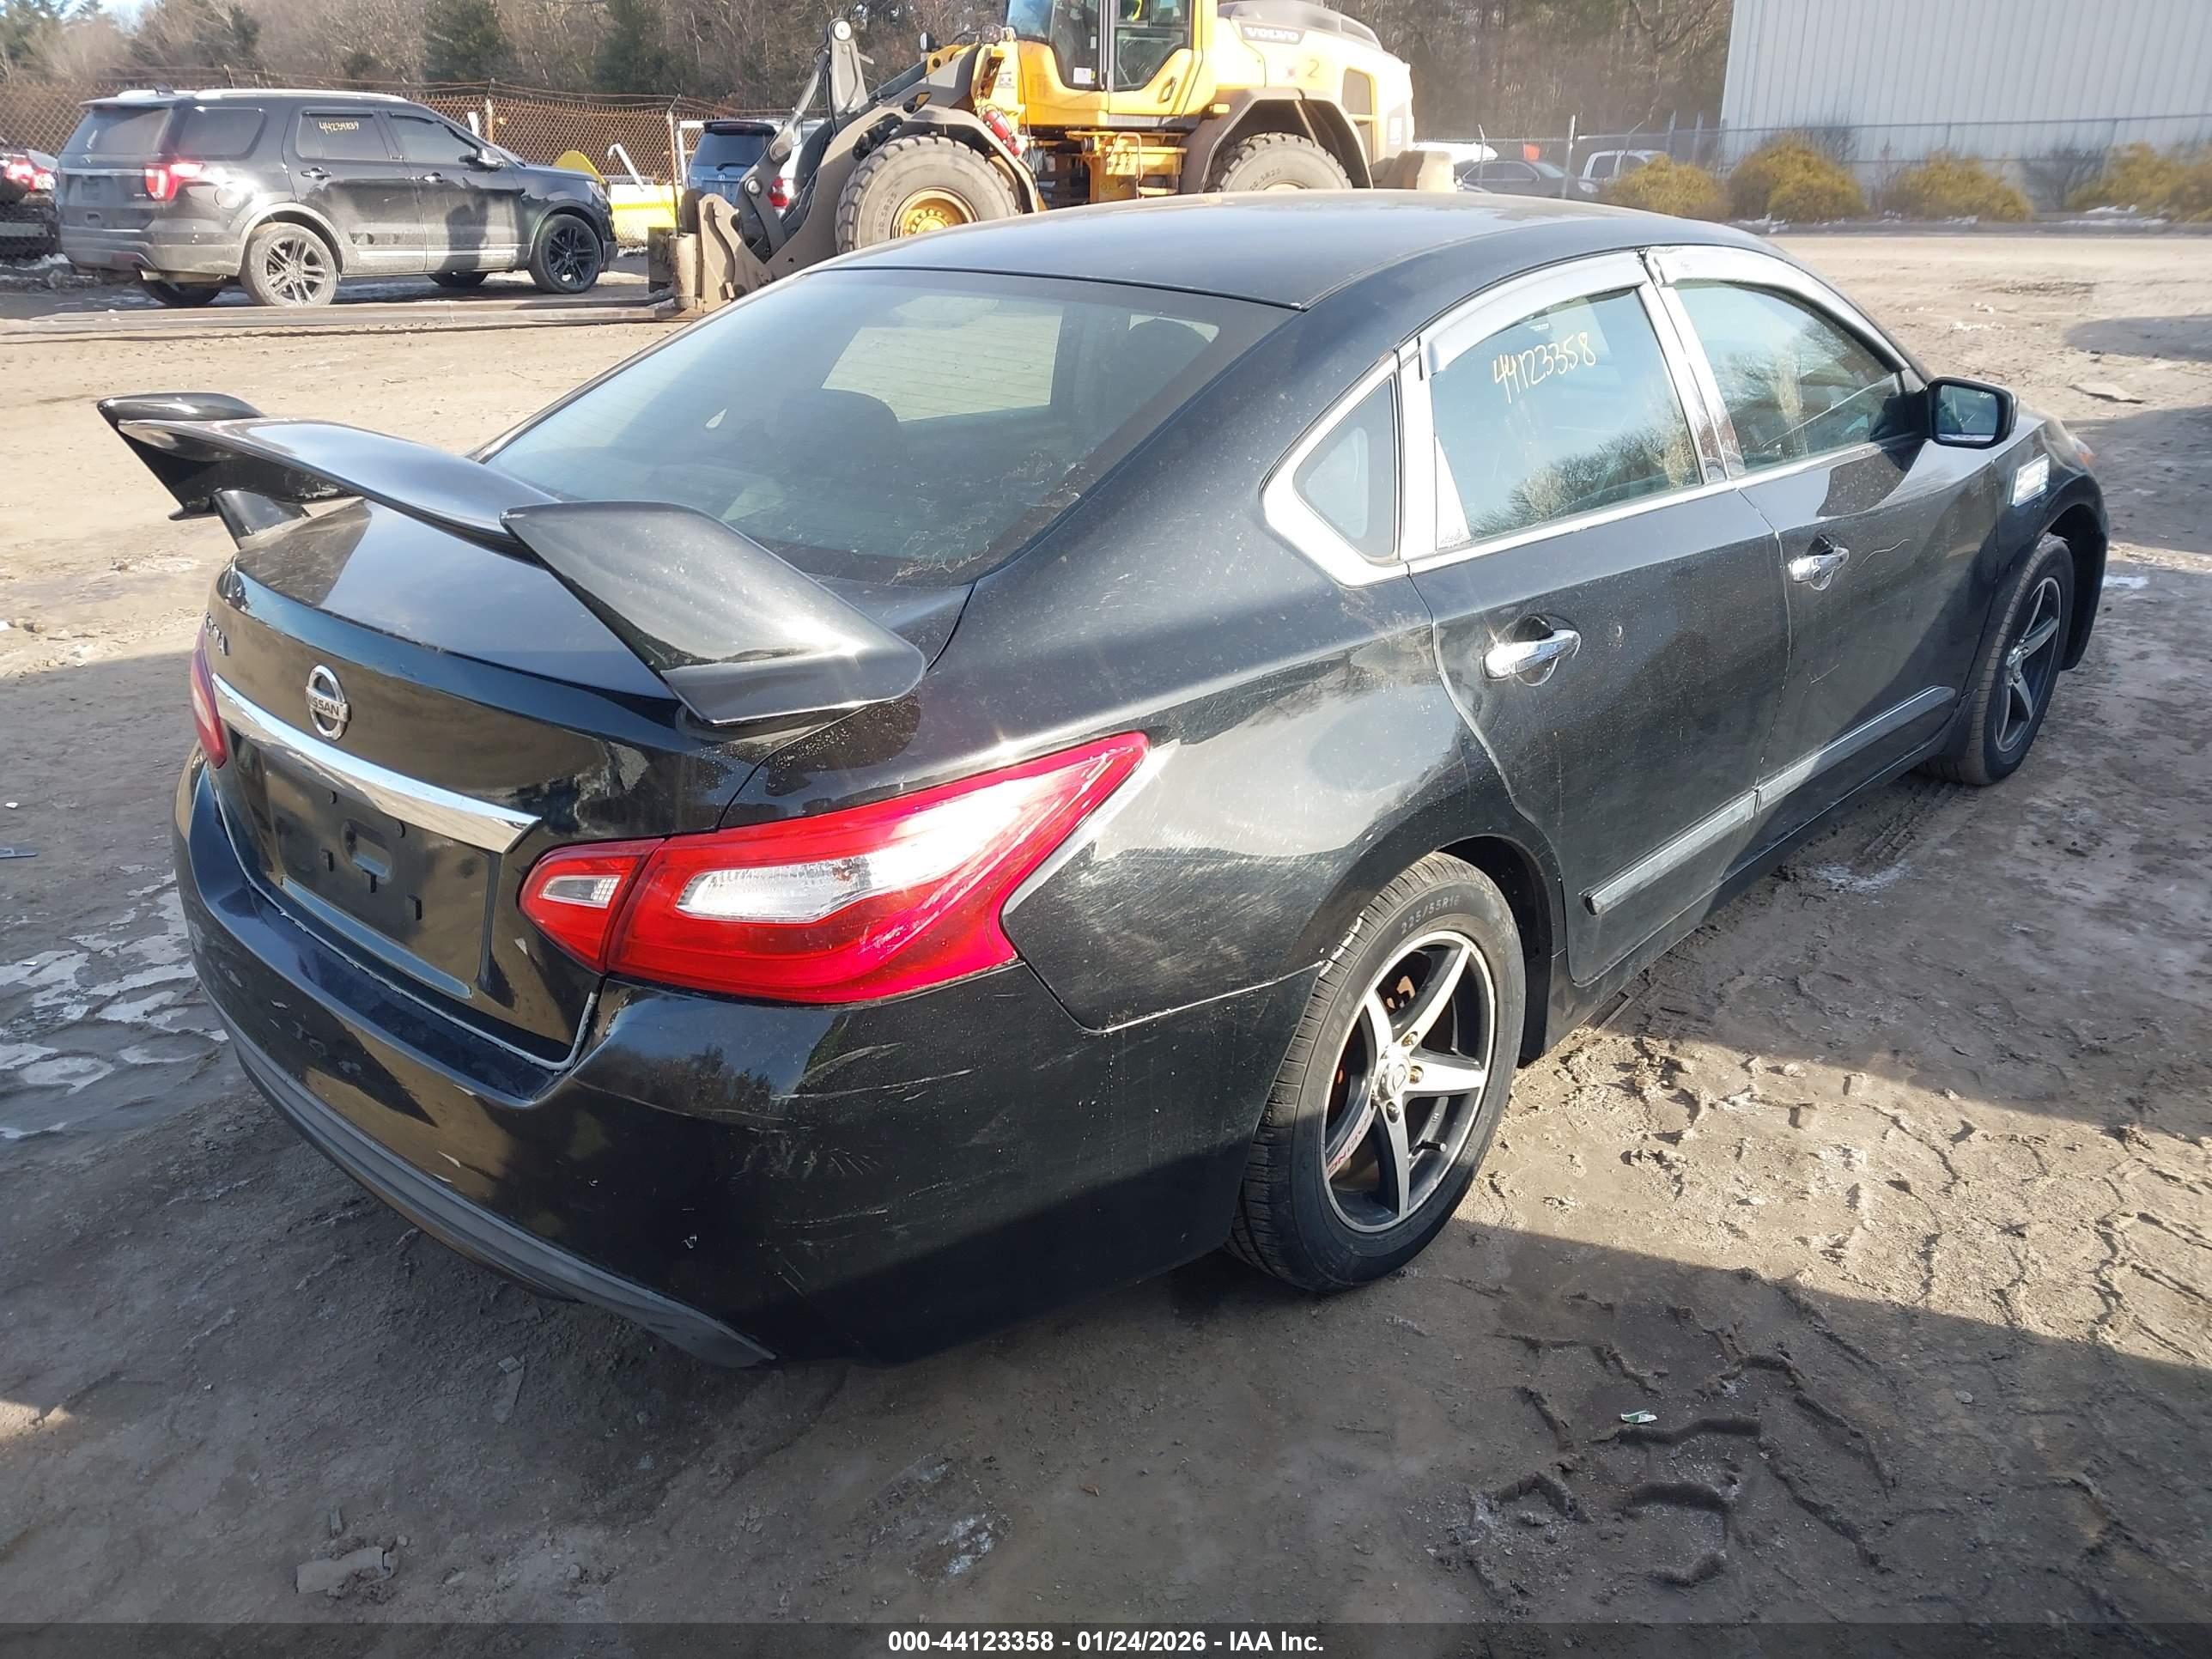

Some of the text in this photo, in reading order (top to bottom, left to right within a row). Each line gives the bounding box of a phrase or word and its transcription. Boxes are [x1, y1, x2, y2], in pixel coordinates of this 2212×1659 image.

[1244, 27, 1299, 42] VOLVO
[1307, 58, 1320, 79] 2
[1493, 331, 1597, 404] 44123358
